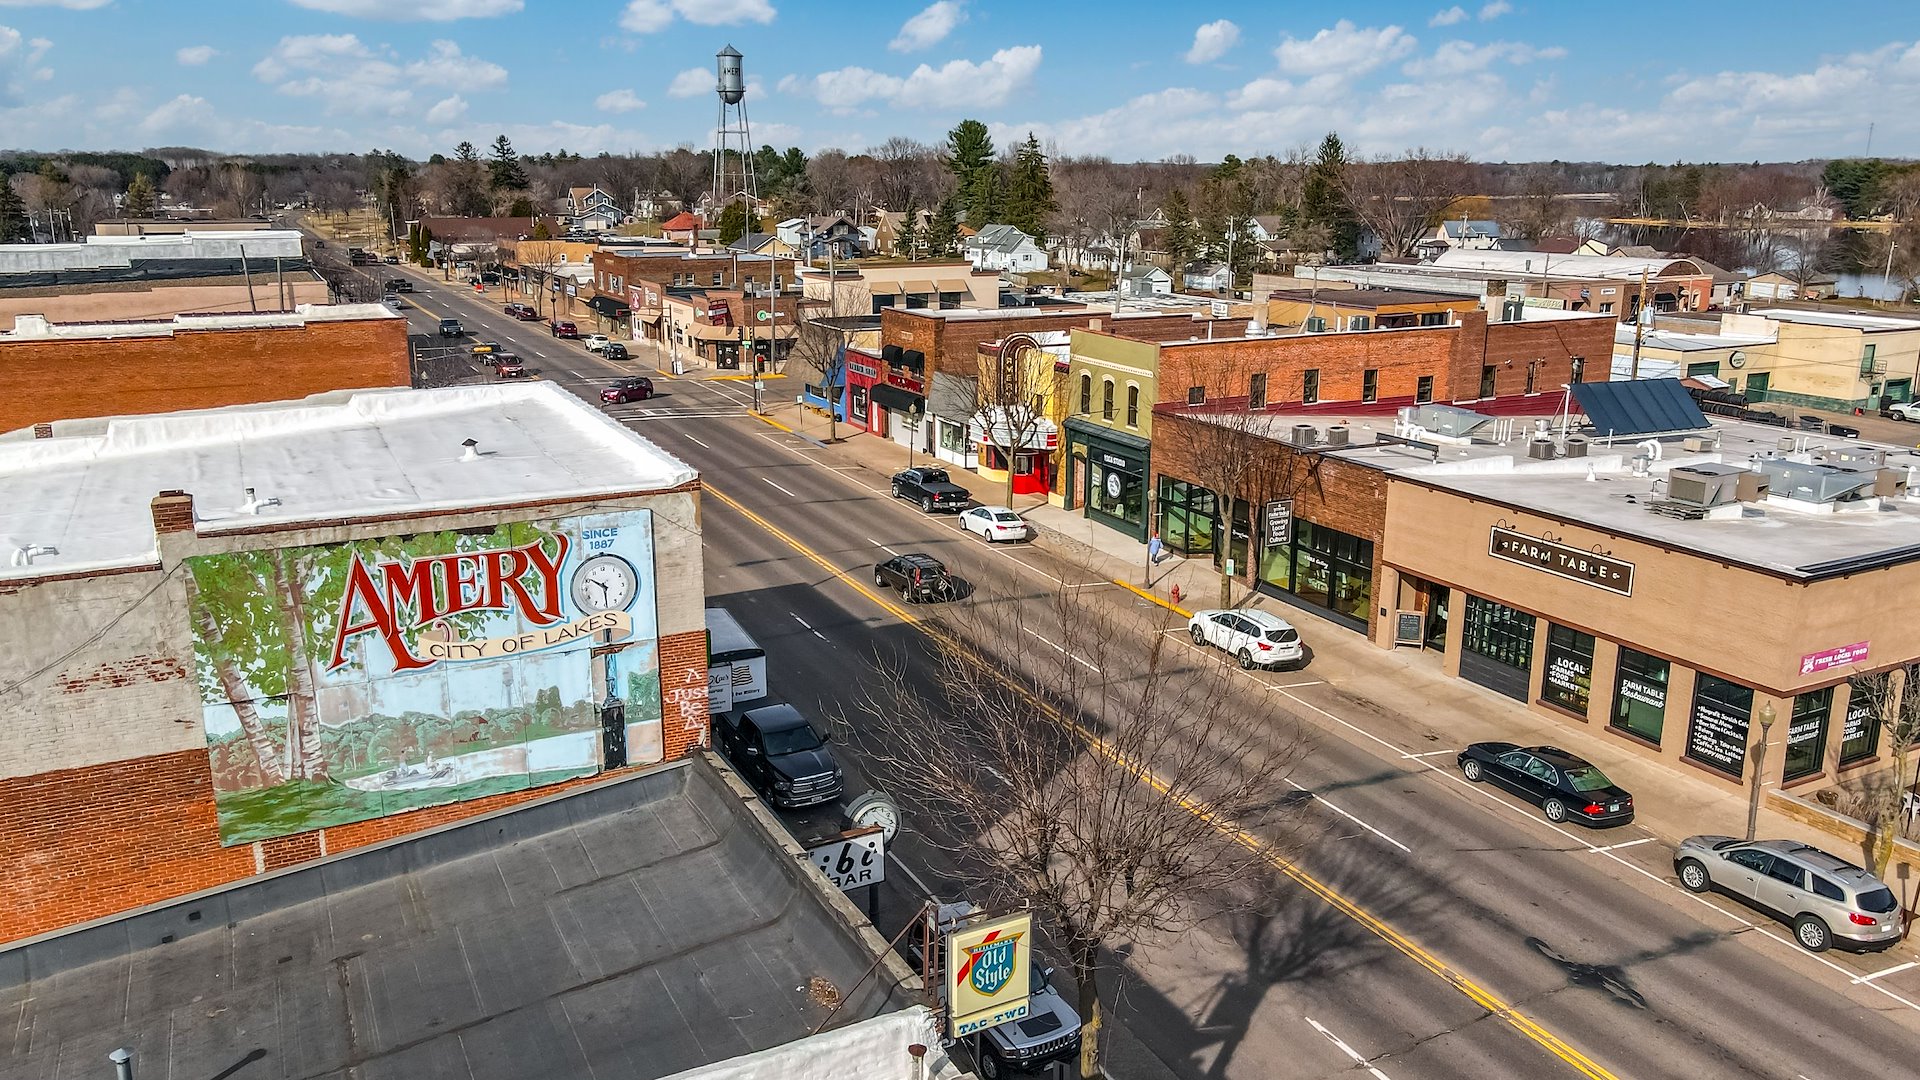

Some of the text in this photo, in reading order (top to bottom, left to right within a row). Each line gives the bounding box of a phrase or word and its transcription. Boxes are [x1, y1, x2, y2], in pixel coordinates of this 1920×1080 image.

[582, 528, 618, 540] SINCE
[590, 539, 614, 550] 1887
[1511, 541, 1608, 578] FARM TABLE
[324, 532, 569, 673] AMERY
[430, 612, 618, 658] CITY OF LAKES
[1552, 664, 1575, 678] FARMS
[1557, 656, 1586, 675] LOCAL
[1550, 676, 1578, 692] MARKET
[1551, 670, 1569, 682] FOOD
[1620, 686, 1664, 708] Restaurant
[1622, 679, 1665, 700] FARM TABLE
[1802, 720, 1820, 732] TABLE
[1694, 745, 1732, 764] HAPPY HOUR
[830, 869, 872, 888] BAR
[982, 946, 1007, 969] Old
[976, 965, 1011, 990] Style
